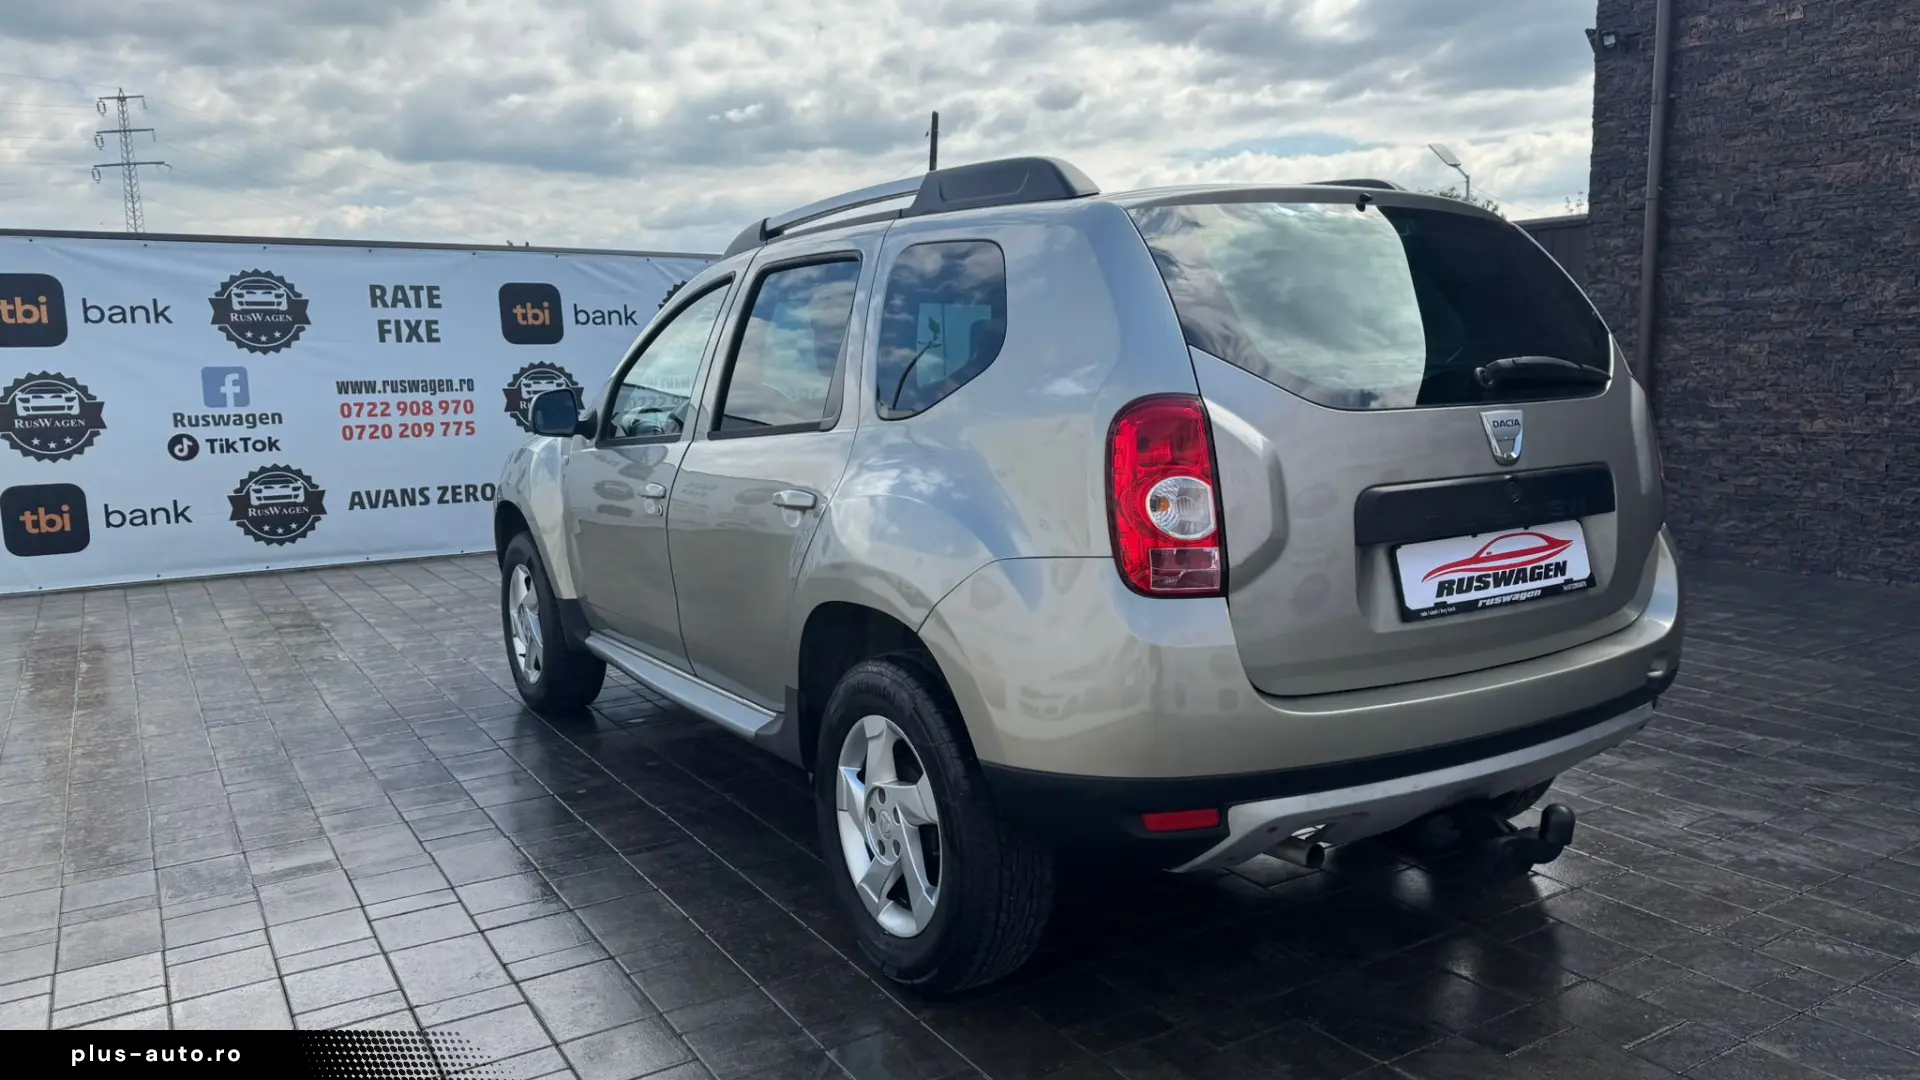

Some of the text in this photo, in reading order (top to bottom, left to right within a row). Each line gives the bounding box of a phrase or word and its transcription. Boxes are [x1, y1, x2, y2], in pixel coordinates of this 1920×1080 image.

[369, 284, 442, 309] RATE
[0, 295, 173, 325] tbi bank
[512, 301, 638, 326] tbi bank
[377, 319, 441, 343] FIXE
[336, 378, 475, 396] www.ruswagen.ro
[339, 399, 474, 418] 0722 908 970
[172, 412, 283, 428] Ruswagen
[341, 420, 475, 441] 0720 209 775
[1492, 418, 1521, 428] DACIA
[205, 436, 281, 454] TikTok
[348, 482, 496, 510] AVANS ZERO
[19, 499, 193, 534] tbi bank
[1435, 560, 1567, 598] RUSWAGEN
[1477, 588, 1541, 608] ruswagen
